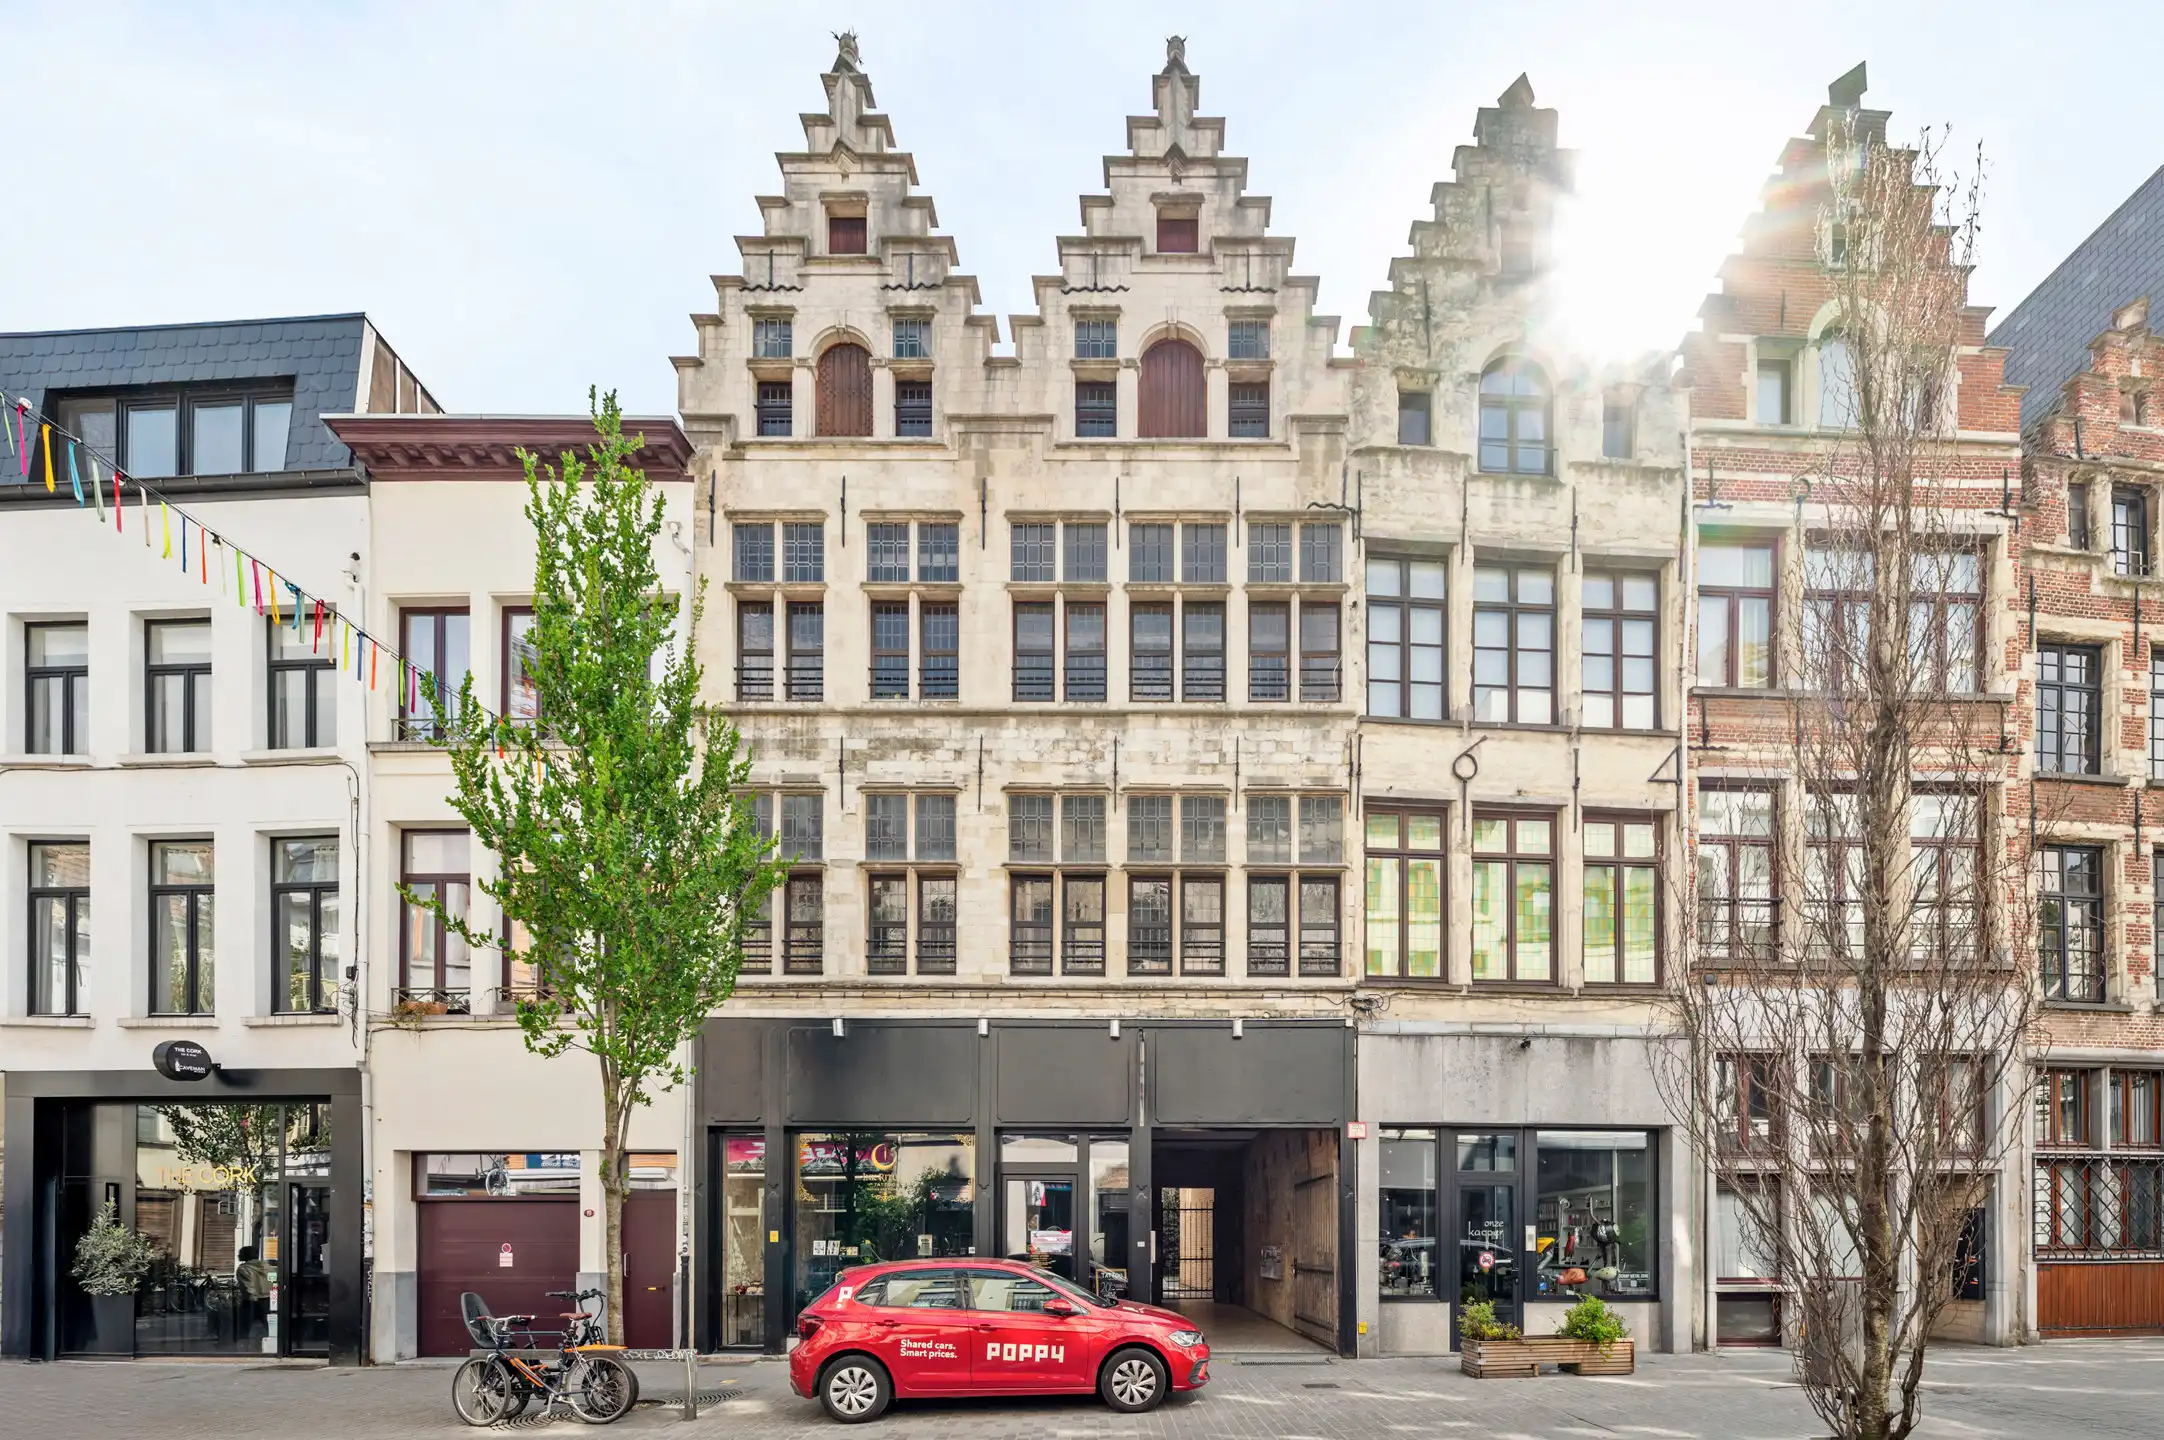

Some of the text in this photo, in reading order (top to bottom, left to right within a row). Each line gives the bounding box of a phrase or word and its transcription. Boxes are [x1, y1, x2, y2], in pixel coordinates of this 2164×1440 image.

[179, 1064, 206, 1072] CAVEMAN
[157, 1166, 258, 1184] THE CORK
[1484, 1220, 1504, 1228] onze
[900, 1339, 956, 1350] Shared cars.
[900, 1348, 958, 1360] Smart prices.
[986, 1342, 1065, 1363] POPPY
